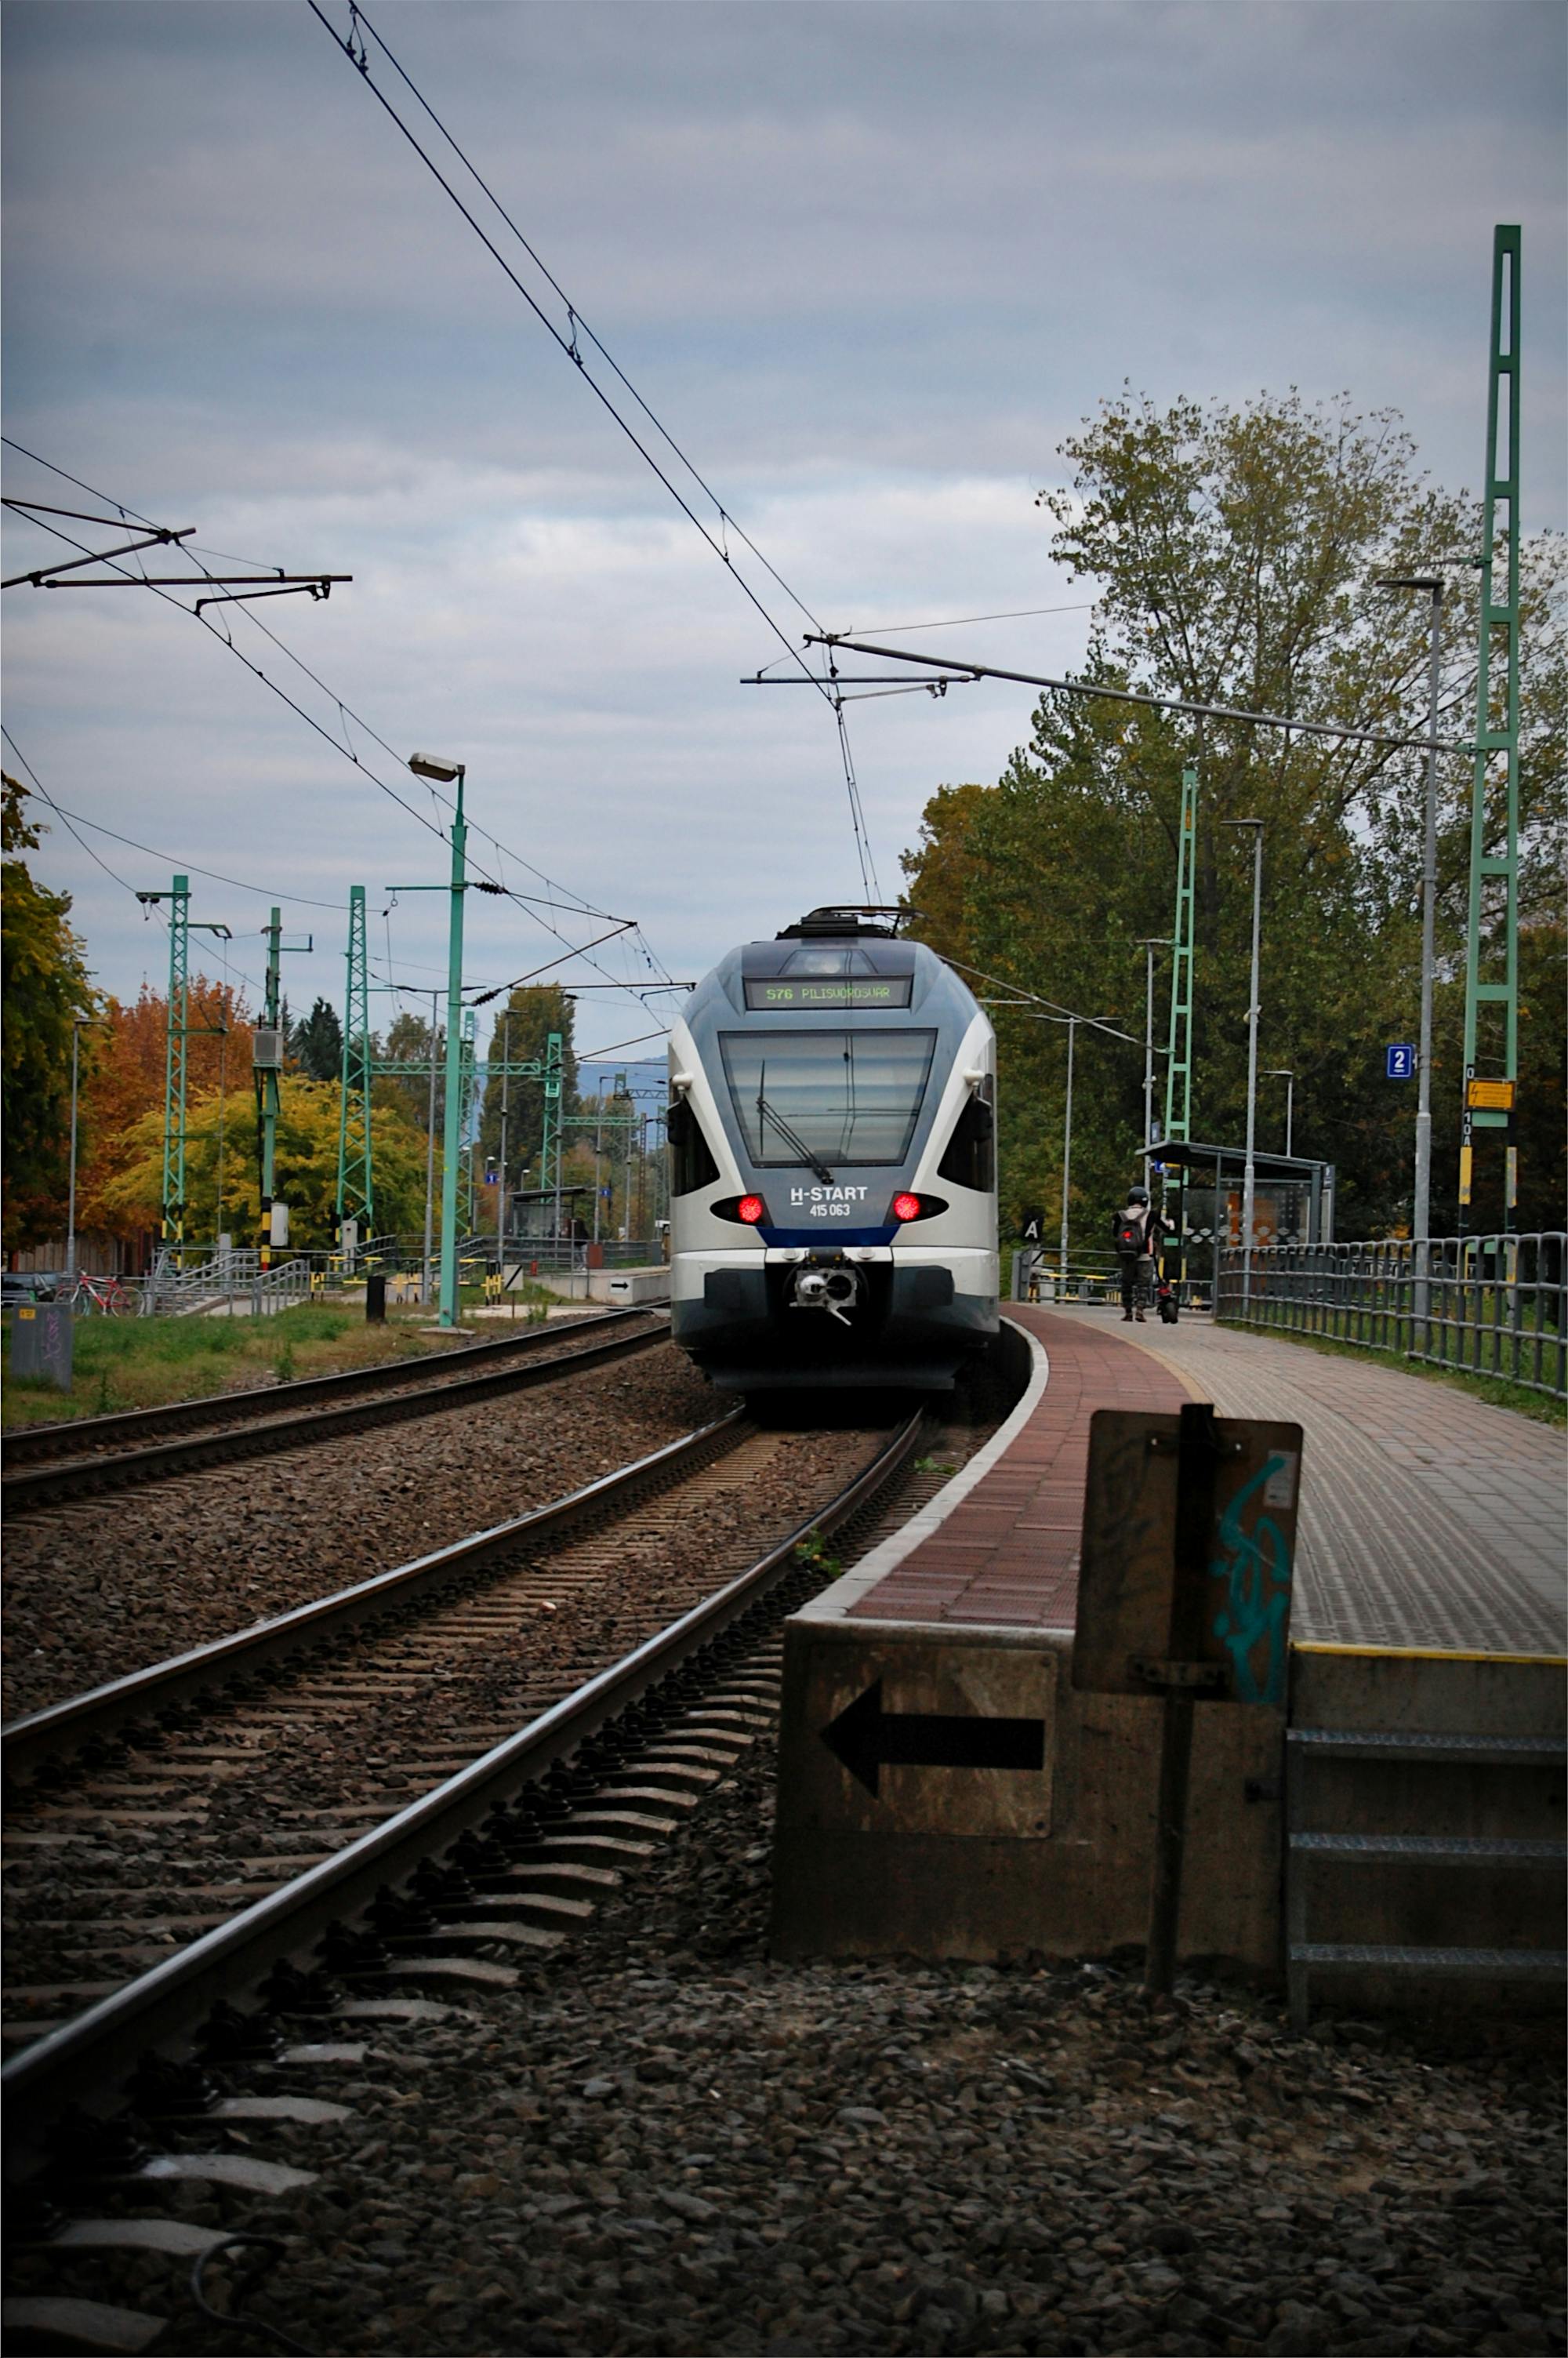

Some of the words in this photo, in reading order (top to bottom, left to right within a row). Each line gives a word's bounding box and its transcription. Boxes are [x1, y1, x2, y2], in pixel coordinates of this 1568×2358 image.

[766, 988, 793, 1001] S76
[1394, 1051, 1405, 1068] 2
[790, 1186, 868, 1205] H-START
[810, 1204, 827, 1216] 415
[829, 1204, 851, 1216] 063
[1025, 1220, 1038, 1238] A
